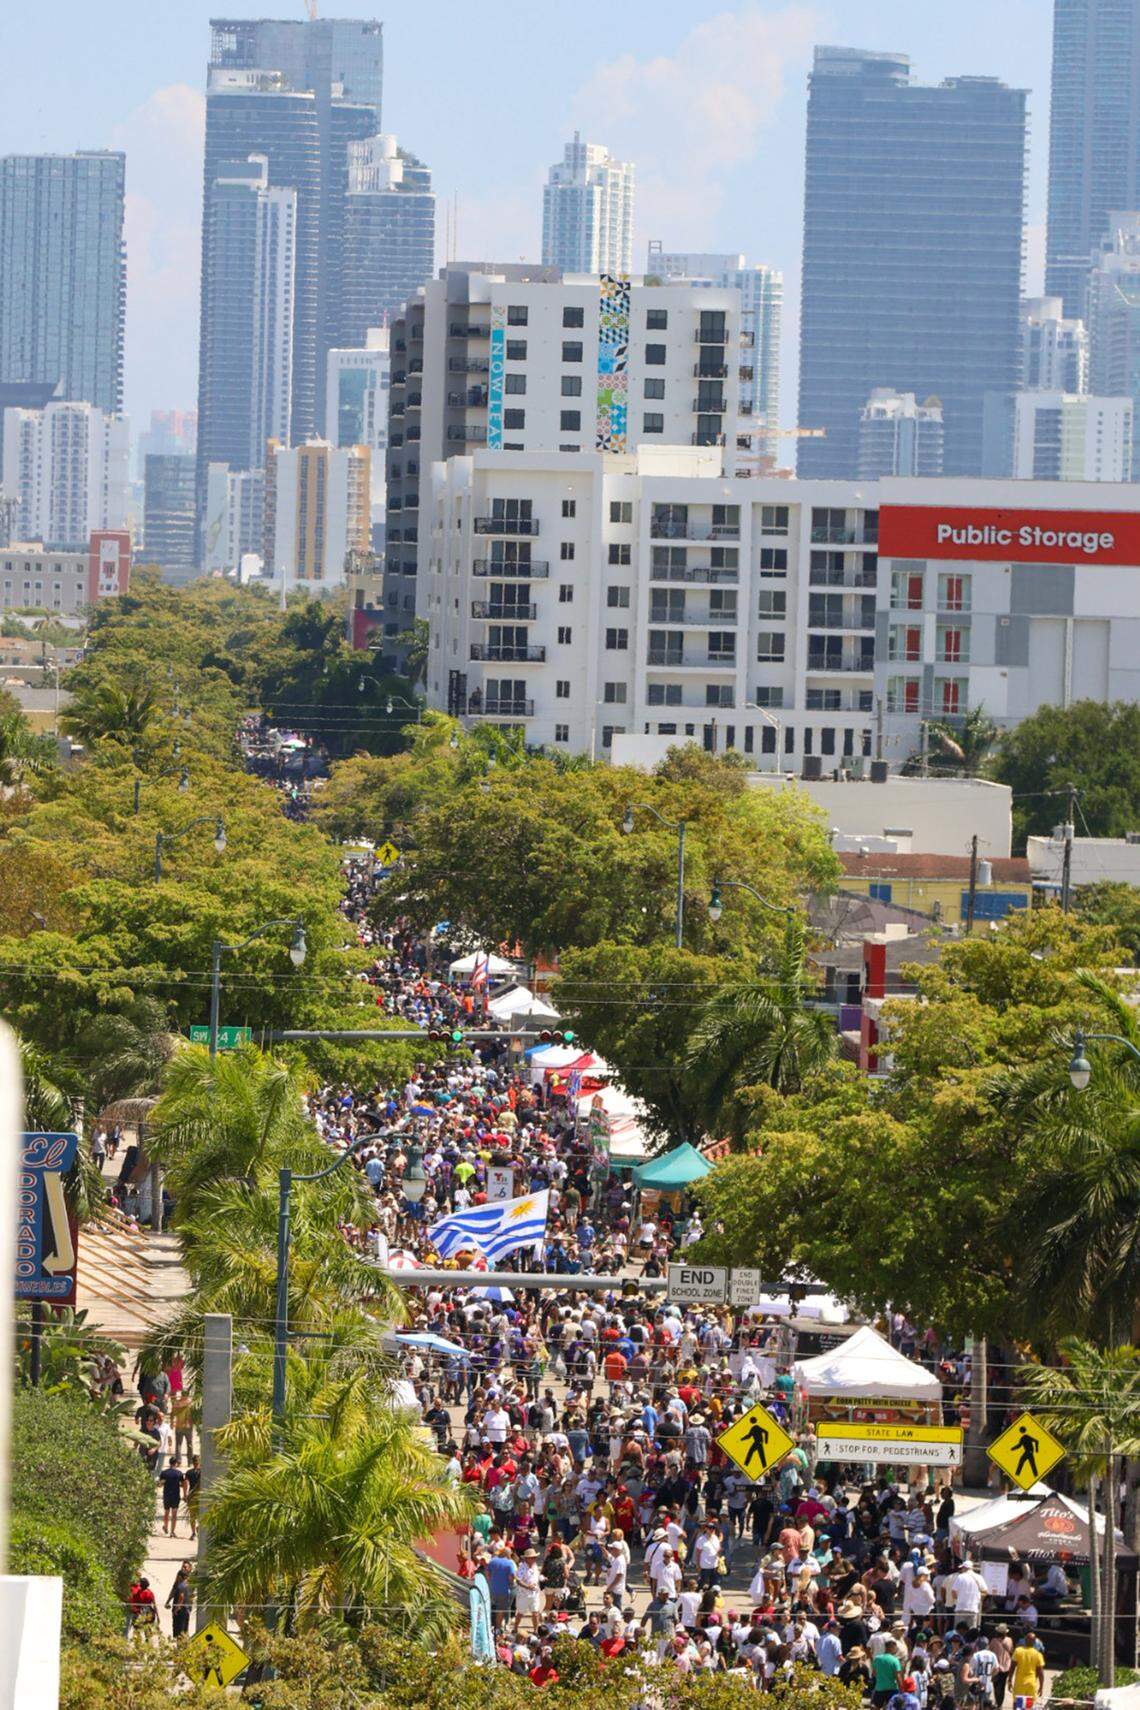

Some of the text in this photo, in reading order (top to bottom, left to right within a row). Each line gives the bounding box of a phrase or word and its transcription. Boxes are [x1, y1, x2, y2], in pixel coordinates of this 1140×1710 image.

[491, 342, 504, 393] NOW
[937, 523, 1115, 554] Public Storage
[193, 1031, 208, 1041] SW
[20, 1137, 68, 1169] El
[16, 1172, 38, 1278] DORADO
[680, 1270, 715, 1285] END
[739, 1271, 753, 1279] END
[671, 1287, 723, 1298] SCHOOL ZONE
[737, 1295, 754, 1303] ZONE
[866, 1428, 914, 1438] STATE LAW
[839, 1445, 940, 1458] STOP FOR PEDESTRIANS
[1039, 1507, 1075, 1520] Tito's
[1028, 1548, 1058, 1560] Tito's
